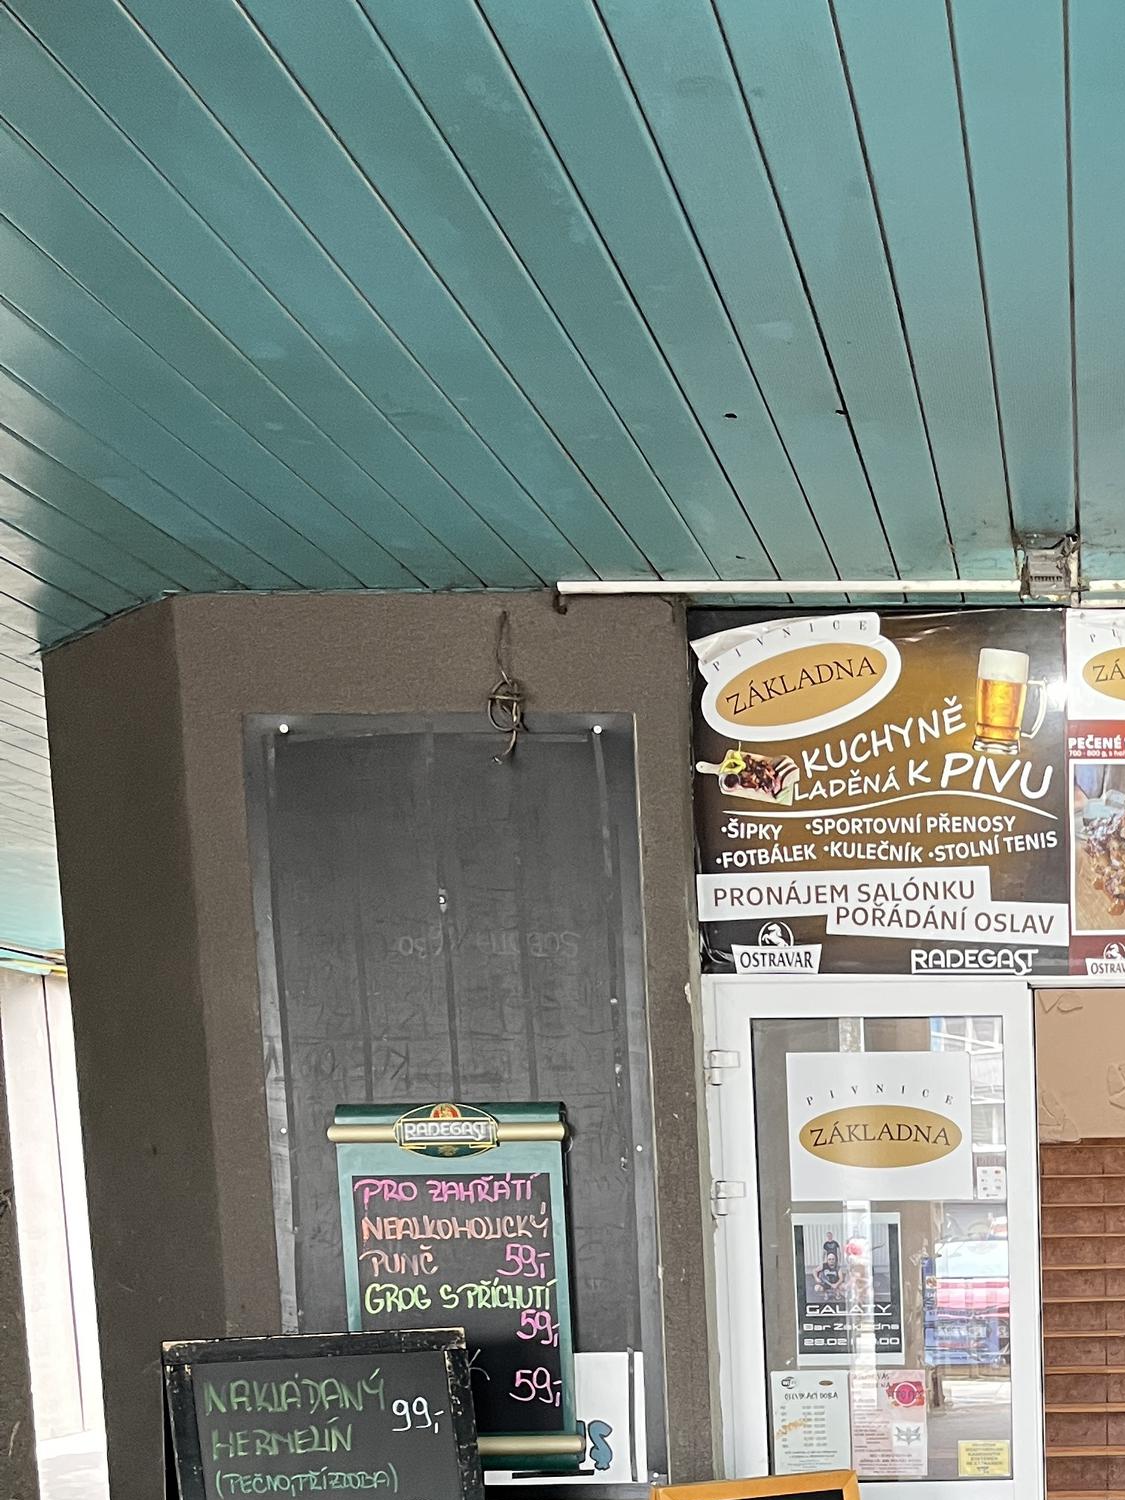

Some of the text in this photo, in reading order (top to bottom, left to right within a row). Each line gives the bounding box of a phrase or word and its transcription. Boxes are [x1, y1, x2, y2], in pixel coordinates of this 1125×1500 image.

[711, 620, 868, 672] PIVNICE
[725, 656, 878, 716] ZÁKLADNA
[801, 696, 967, 778] KUCHYNĚ
[1068, 734, 1121, 750] PEČENÉ
[794, 752, 1053, 801] LADĚNÁ K PIVU
[927, 812, 1016, 833] PŘENOSY
[1003, 831, 1058, 853] TENIS
[713, 876, 976, 907] PRONÁJEM SALÓNKU
[835, 902, 1055, 935] POŘÁDÁNÍ OSLAV
[739, 949, 1039, 975] OSTRAVAR RADEGAST
[806, 1084, 954, 1106] PIVNICE
[404, 1121, 488, 1142] RADEGAST
[809, 1121, 951, 1148] ZÁKLADNA
[354, 1178, 417, 1206] PRO
[361, 1202, 549, 1241] NEALKOHOLICKÝ
[359, 1244, 438, 1277] PUNČ
[365, 1283, 431, 1314] GROG
[440, 1284, 459, 1309] S
[803, 1323, 831, 1331] Bar
[204, 1368, 386, 1415] NAKLÁDANÝ
[211, 1416, 352, 1460] HERMELÍN
